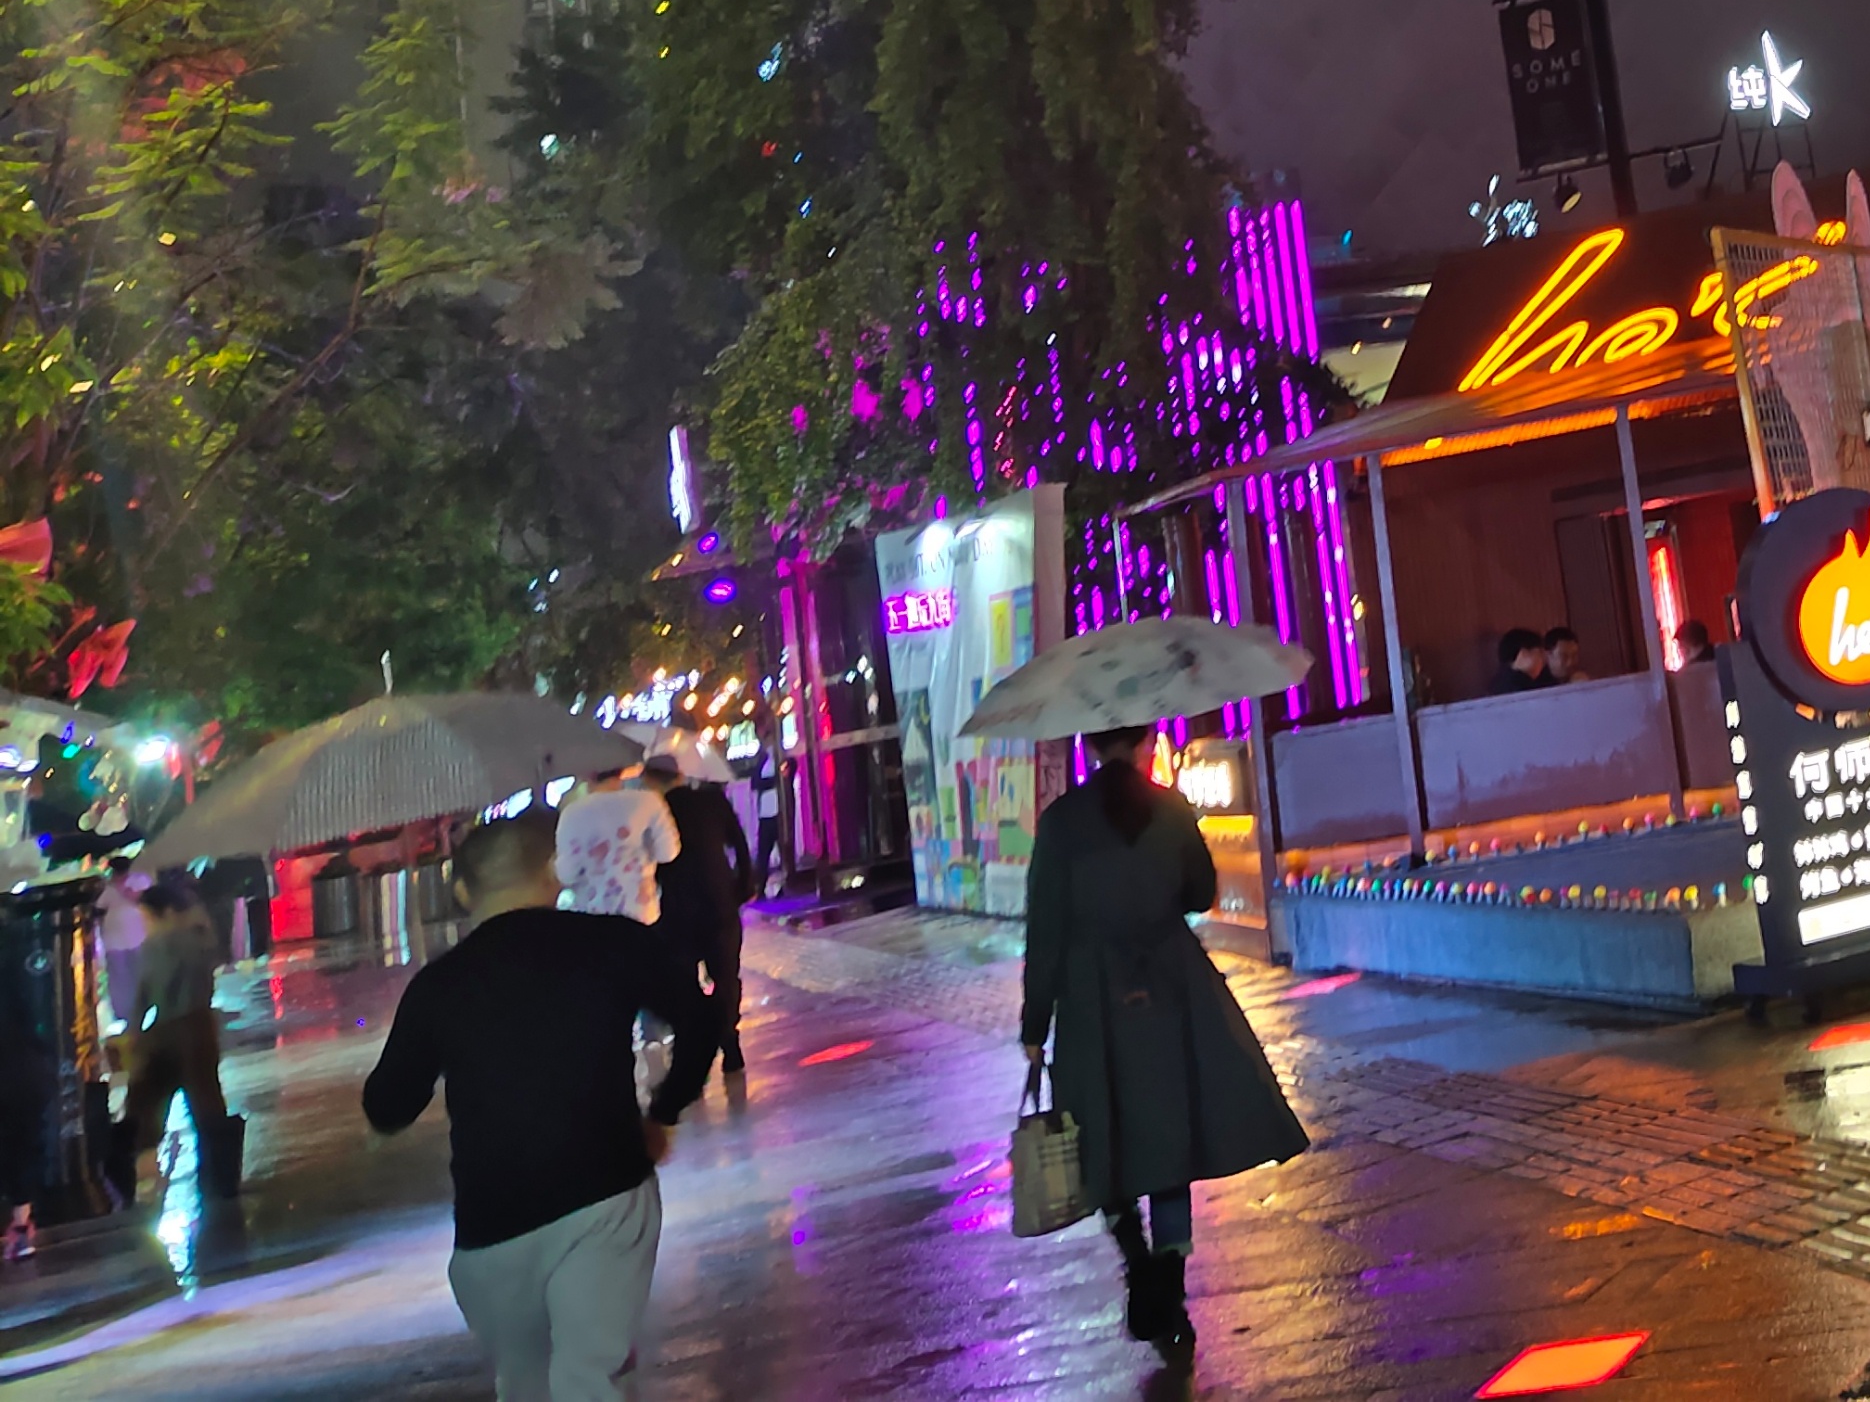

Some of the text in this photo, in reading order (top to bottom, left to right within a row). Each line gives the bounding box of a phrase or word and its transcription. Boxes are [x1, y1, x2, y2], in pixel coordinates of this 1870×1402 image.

[1511, 49, 1581, 79] SOME
[1727, 30, 1812, 127] 纯K
[1526, 72, 1572, 94] ONE
